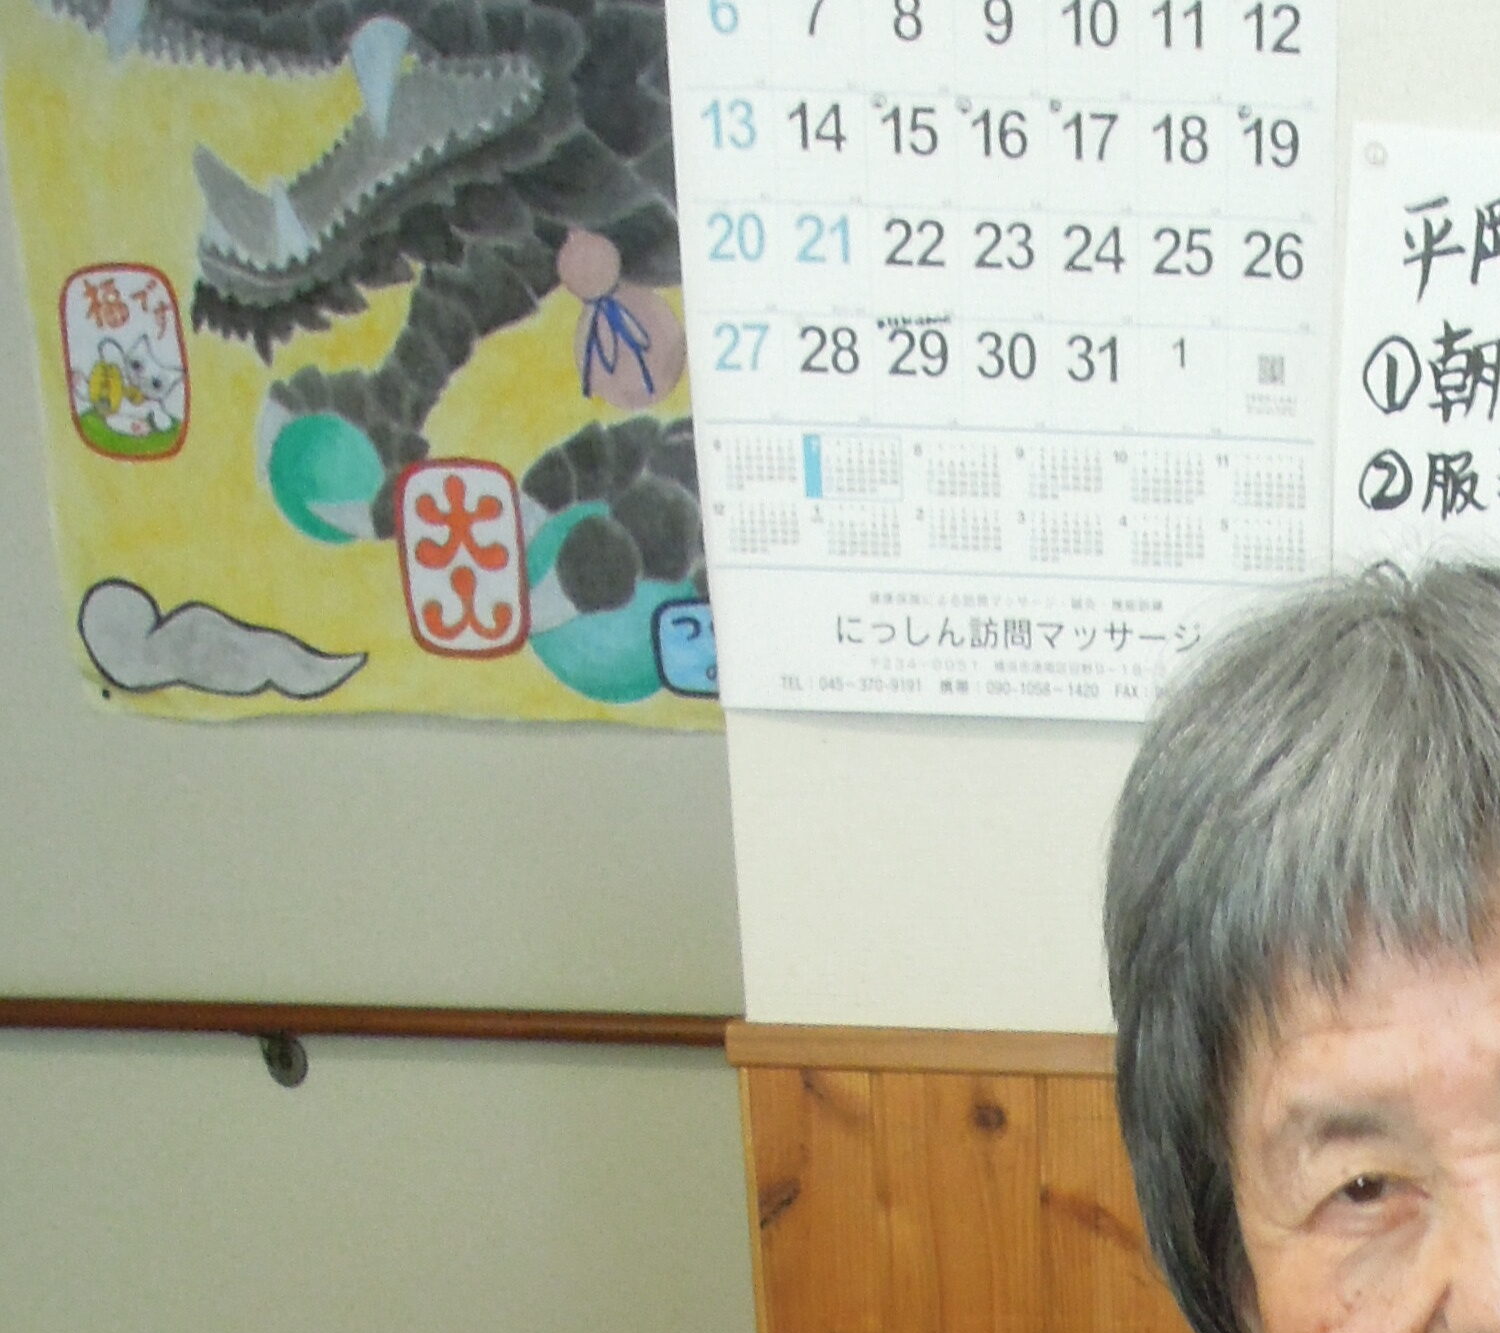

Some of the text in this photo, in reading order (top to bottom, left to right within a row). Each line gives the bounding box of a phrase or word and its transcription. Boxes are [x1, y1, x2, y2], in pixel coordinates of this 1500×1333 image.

[709, 0, 739, 33] 6
[894, 0, 922, 41] 8
[984, 0, 1013, 44] 9
[1063, 0, 1118, 47] 10
[1152, 0, 1203, 49] 11
[1244, 2, 1300, 54] 12
[702, 99, 1299, 168] 13 14 15 16 17 18 19
[708, 211, 1303, 280] 20 21 22 23 24 25 26
[714, 322, 1185, 382] 27 28 29 30 31 1
[836, 615, 1201, 653] にっしん訪問マッサージ
